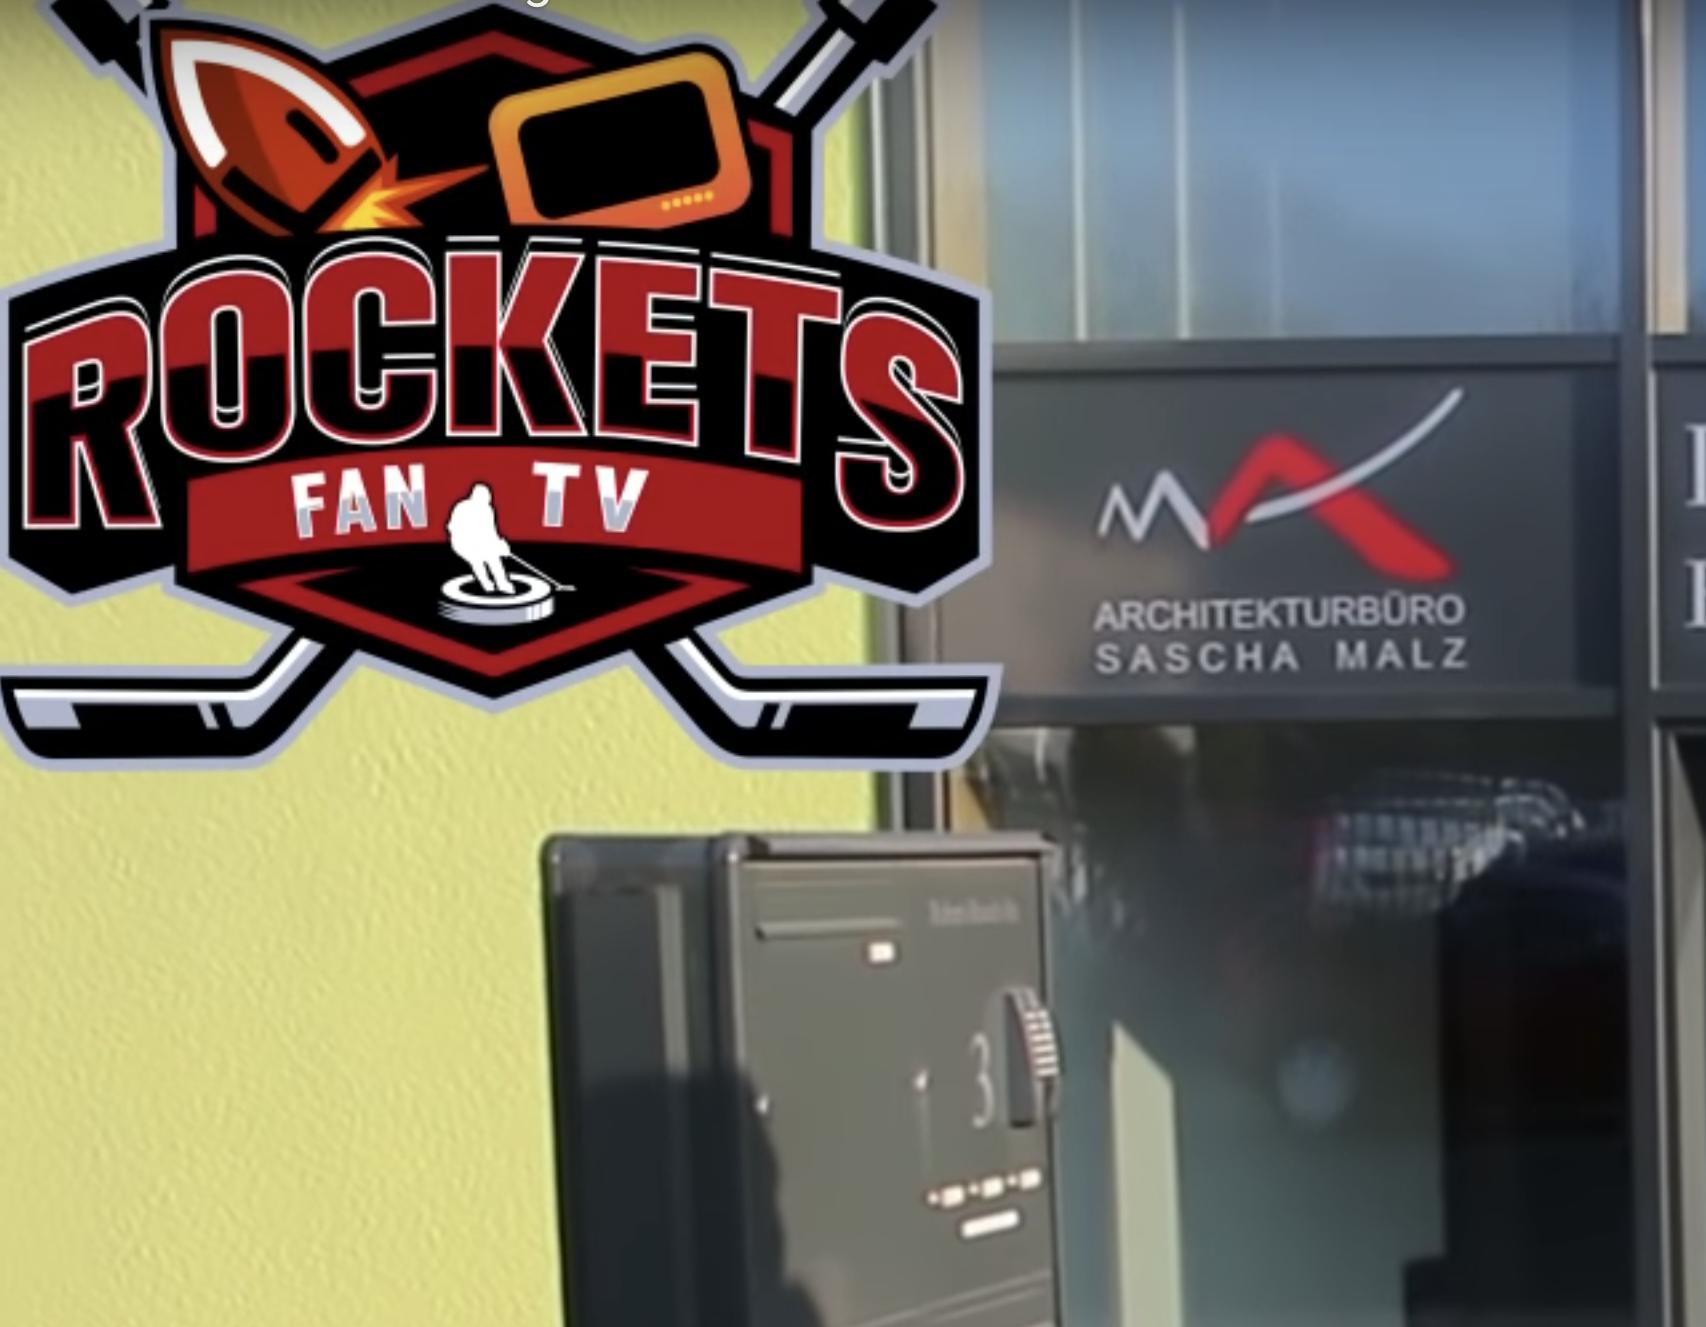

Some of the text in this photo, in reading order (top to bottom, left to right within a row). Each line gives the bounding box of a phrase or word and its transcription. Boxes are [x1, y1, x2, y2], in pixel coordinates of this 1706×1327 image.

[1093, 590, 1467, 632] ARCHITEKTURBÜRO
[1095, 635, 1468, 675] SASCHA MALZ
[969, 1031, 996, 1129] 3
